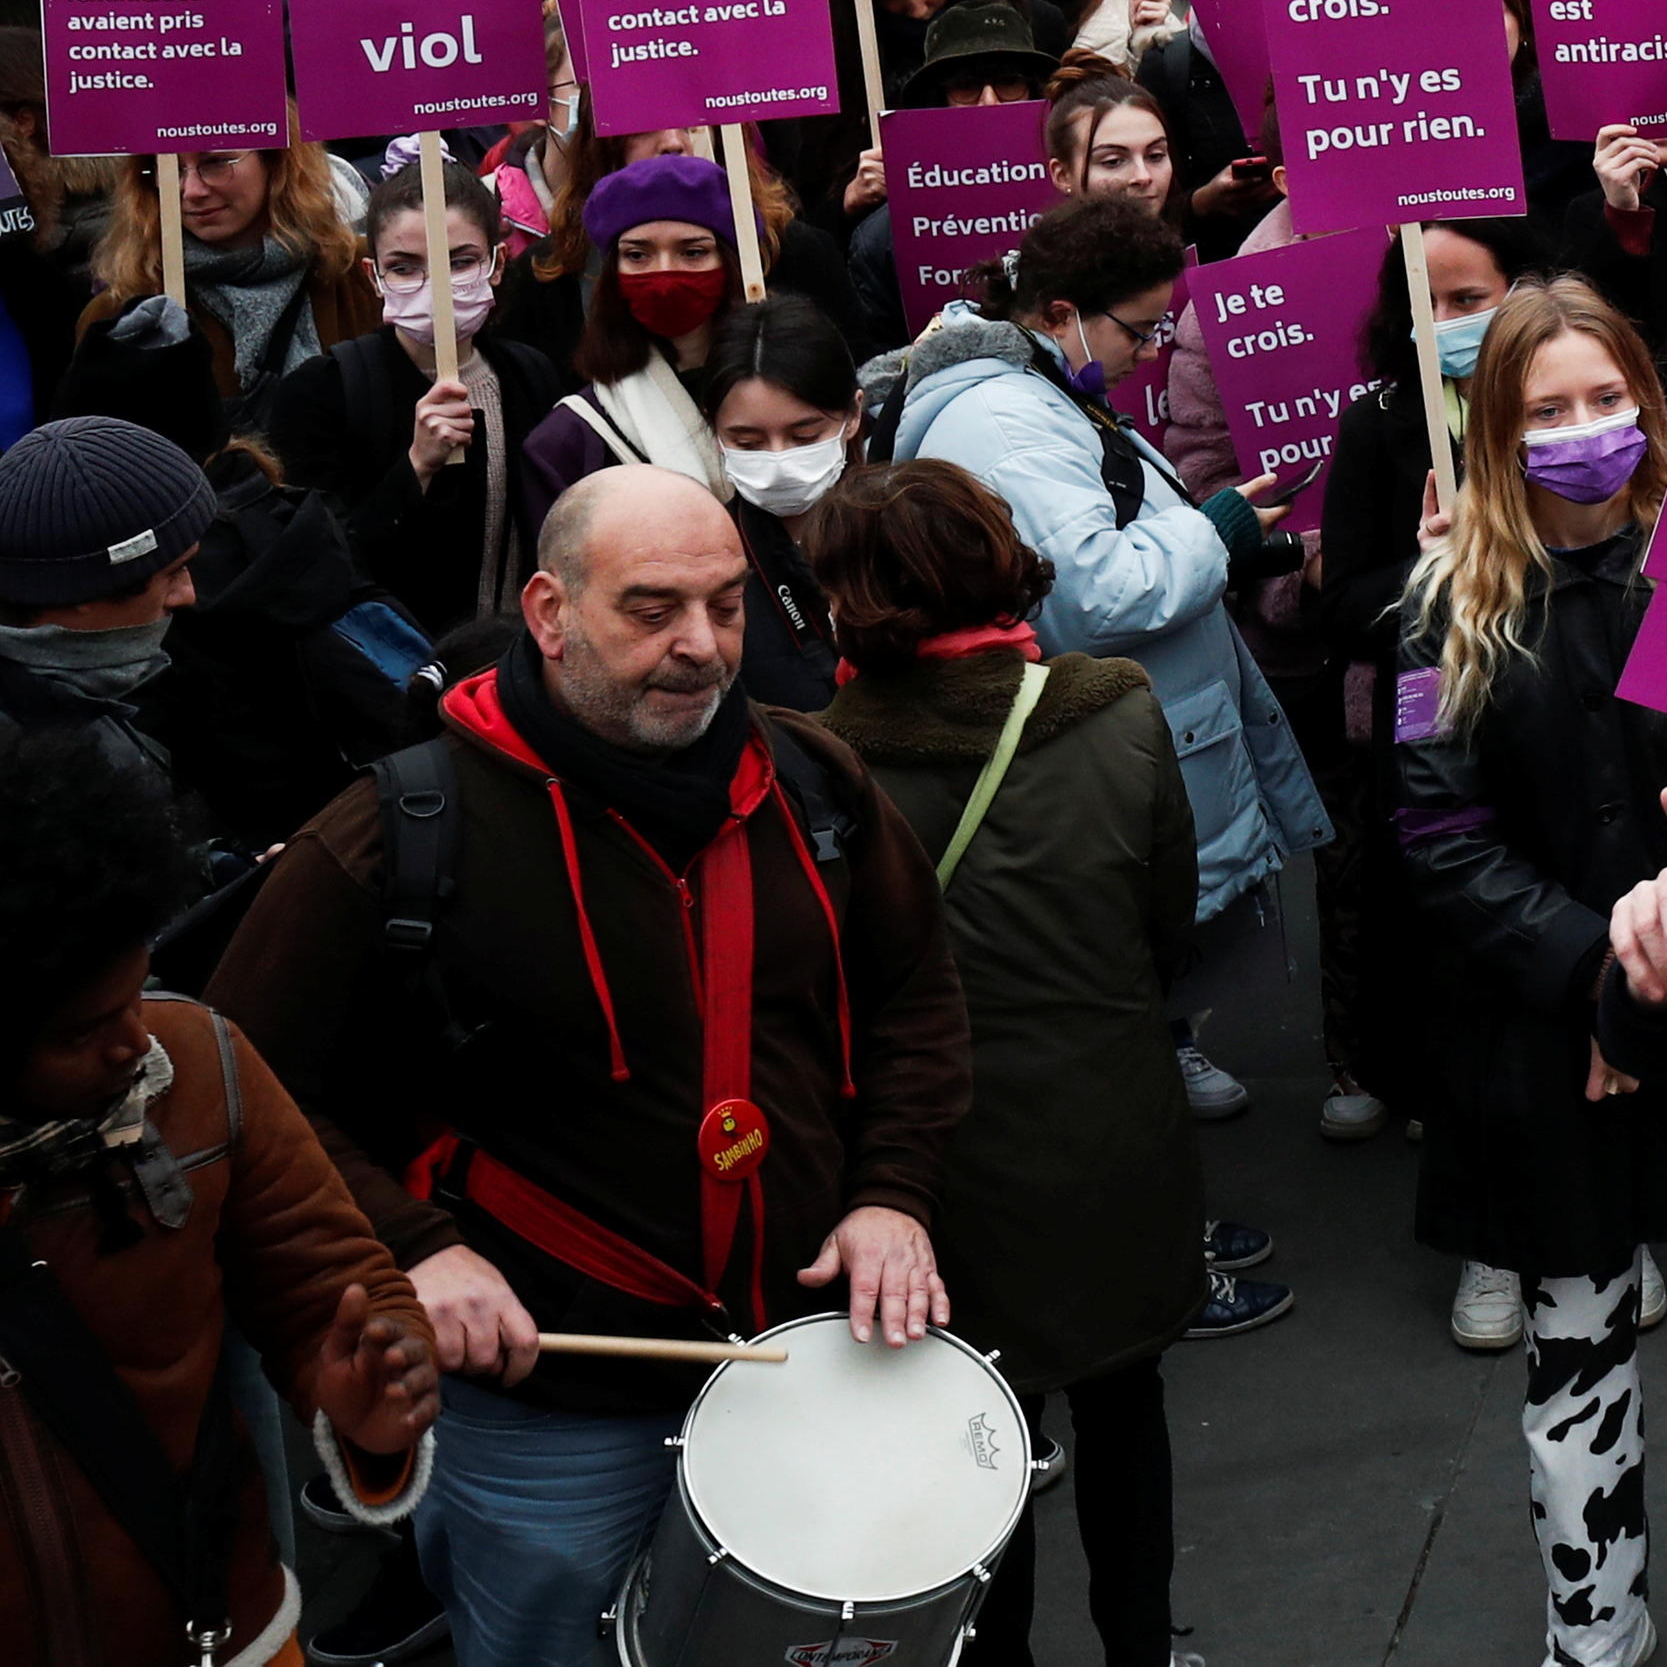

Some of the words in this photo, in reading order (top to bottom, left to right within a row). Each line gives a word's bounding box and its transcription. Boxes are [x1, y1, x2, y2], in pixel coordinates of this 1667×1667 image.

[68, 12, 154, 30] avaient
[160, 11, 204, 34] pris
[69, 42, 157, 60] contact
[162, 43, 216, 58] avec
[221, 37, 242, 56] la
[360, 15, 482, 72] viol
[69, 71, 153, 94] justice.
[1298, 75, 1347, 103] Tu
[1356, 69, 1410, 104] n'y
[1420, 69, 1461, 92] es
[157, 123, 276, 137] noustoutes.org
[1306, 123, 1393, 160] pour
[1403, 111, 1484, 142] rien.
[1398, 187, 1515, 206] noustoutes.org
[778, 585, 805, 630] Canon
[972, 1422, 988, 1463] REMO
